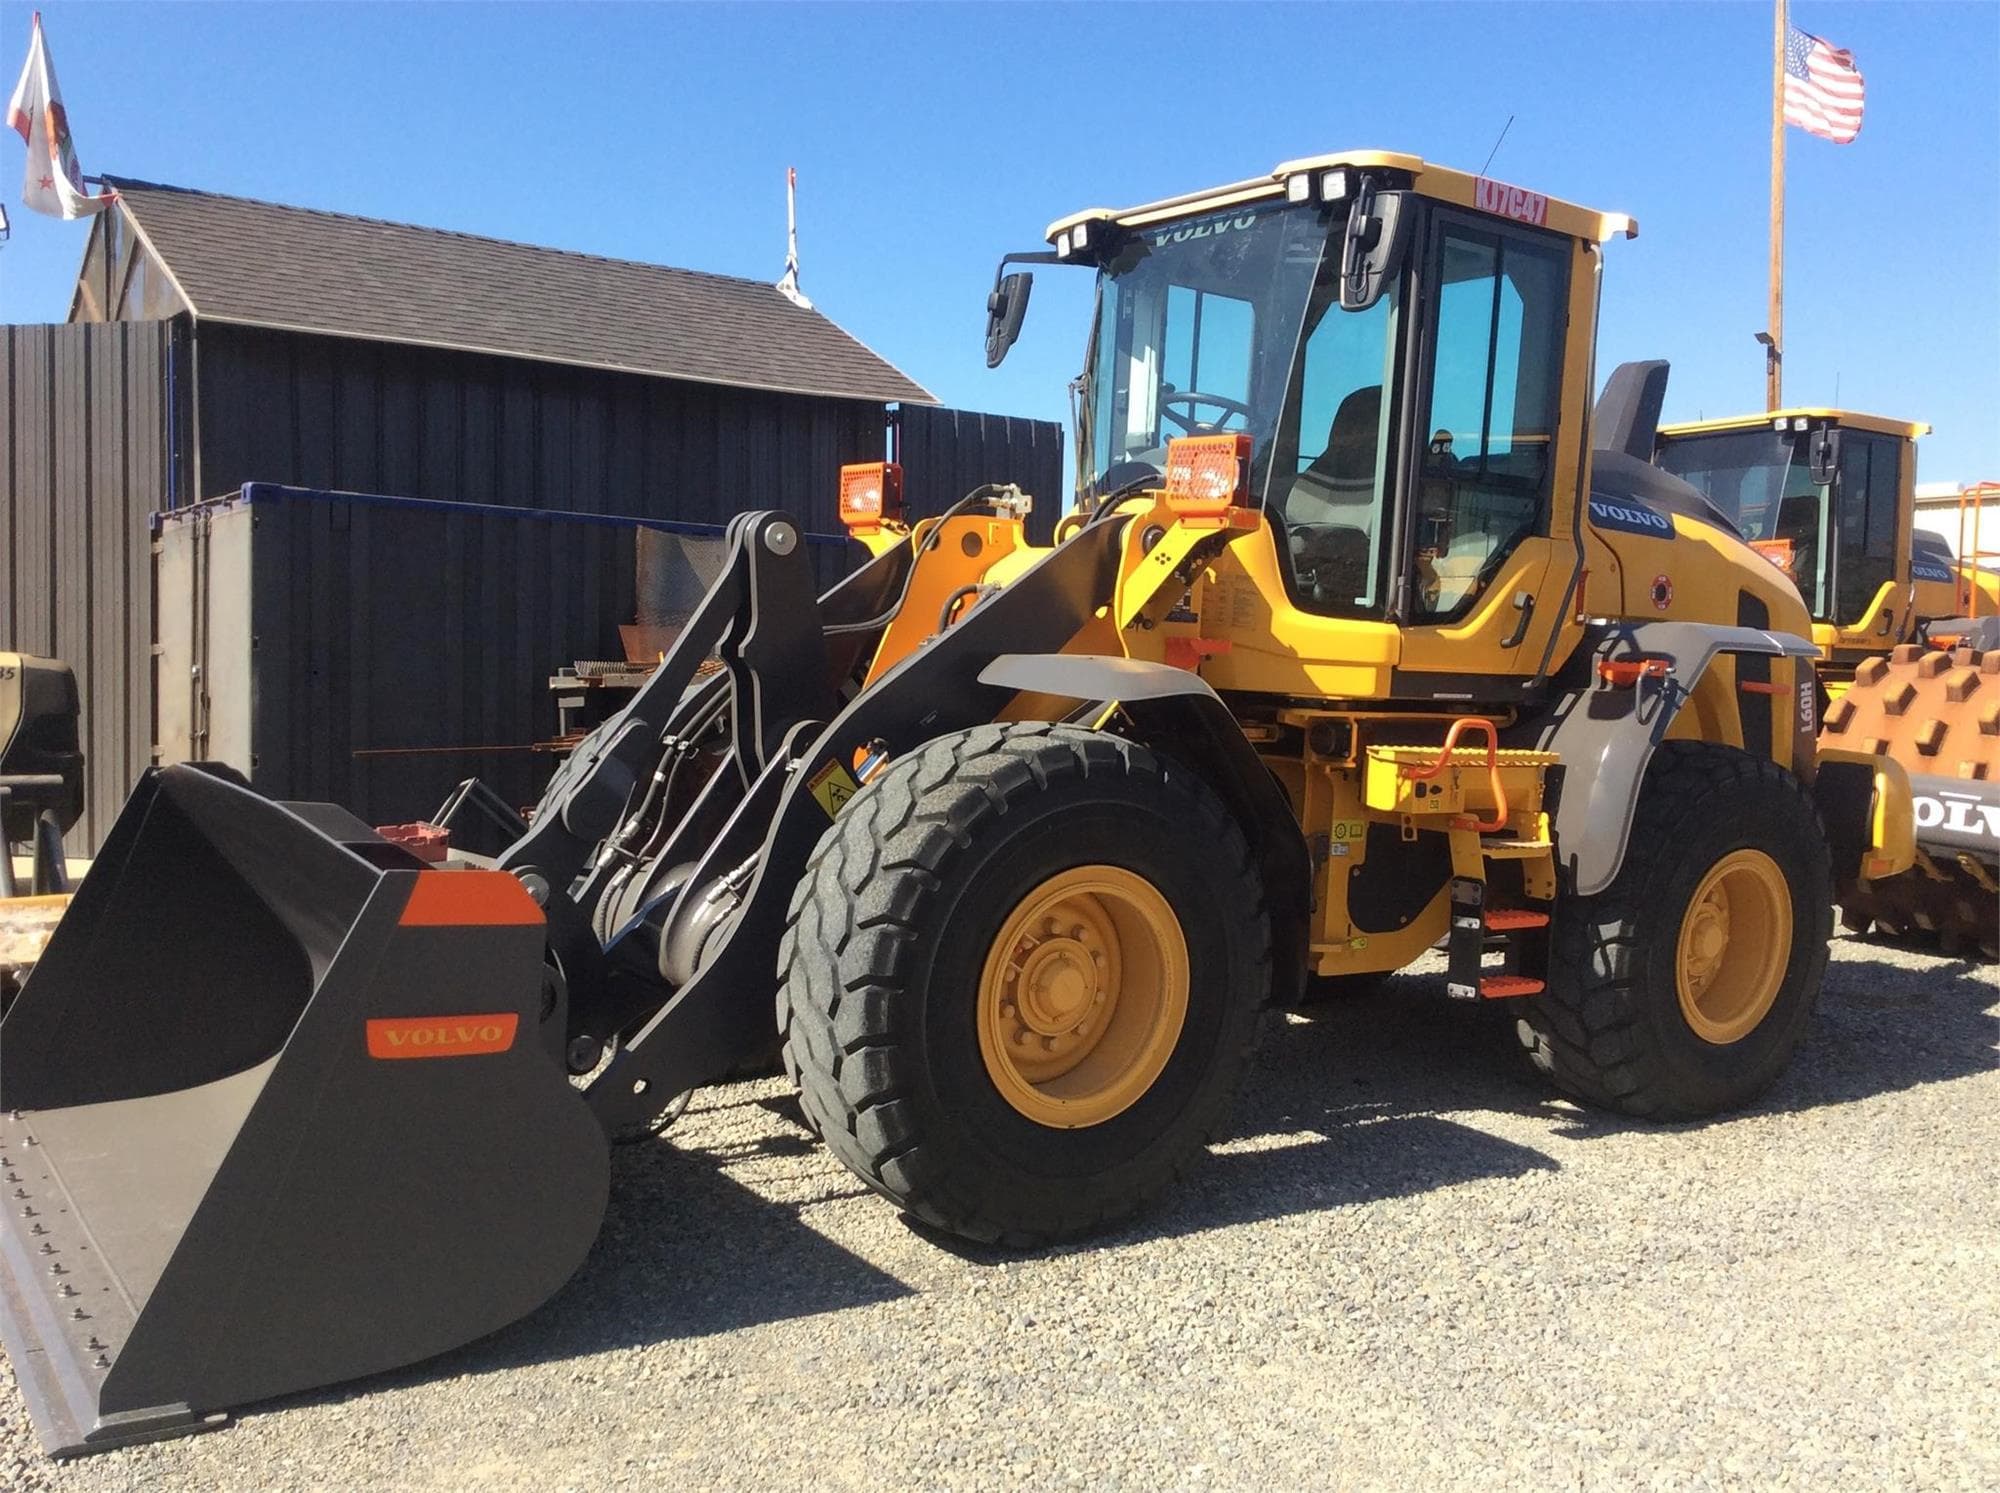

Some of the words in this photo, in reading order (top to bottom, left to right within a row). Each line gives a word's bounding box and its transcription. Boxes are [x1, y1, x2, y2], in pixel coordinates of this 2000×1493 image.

[1589, 502, 1668, 529] VOLVO
[1912, 566, 1948, 578] OLVO
[1801, 681, 1812, 732] L60H
[1912, 796, 2000, 838] OLV
[385, 1025, 502, 1046] VOLVO
